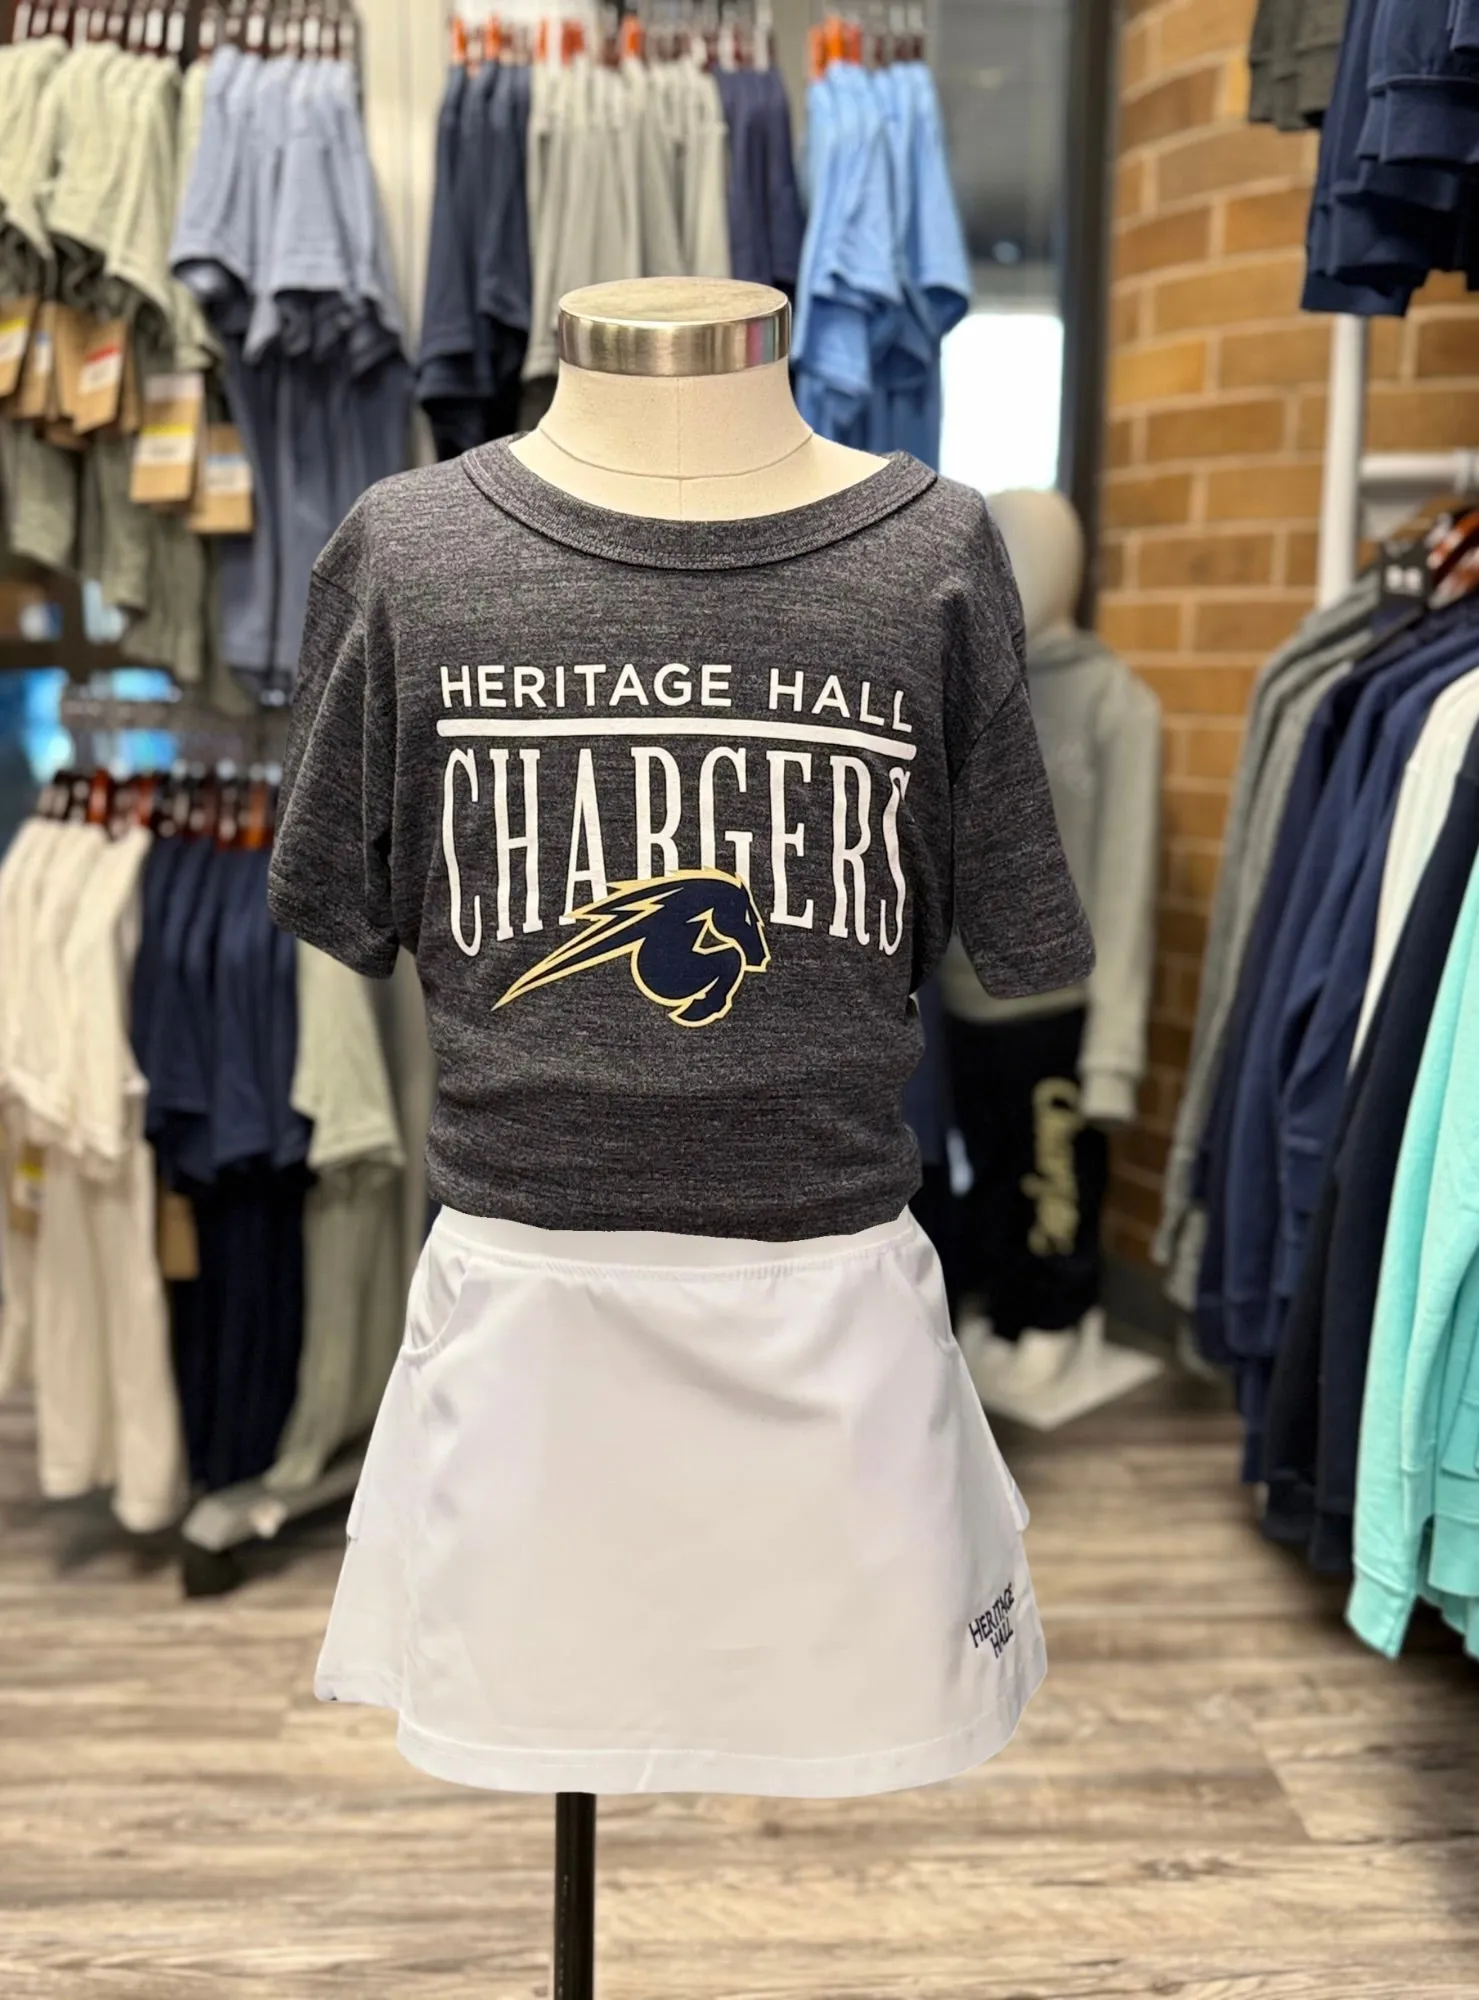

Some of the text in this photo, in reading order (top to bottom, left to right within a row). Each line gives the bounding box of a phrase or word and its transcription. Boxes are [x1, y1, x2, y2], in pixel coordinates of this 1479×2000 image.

[440, 663, 912, 732] HERITAGE HALL
[442, 746, 911, 956] CHARGERS
[989, 1616, 1013, 1659] HALL
